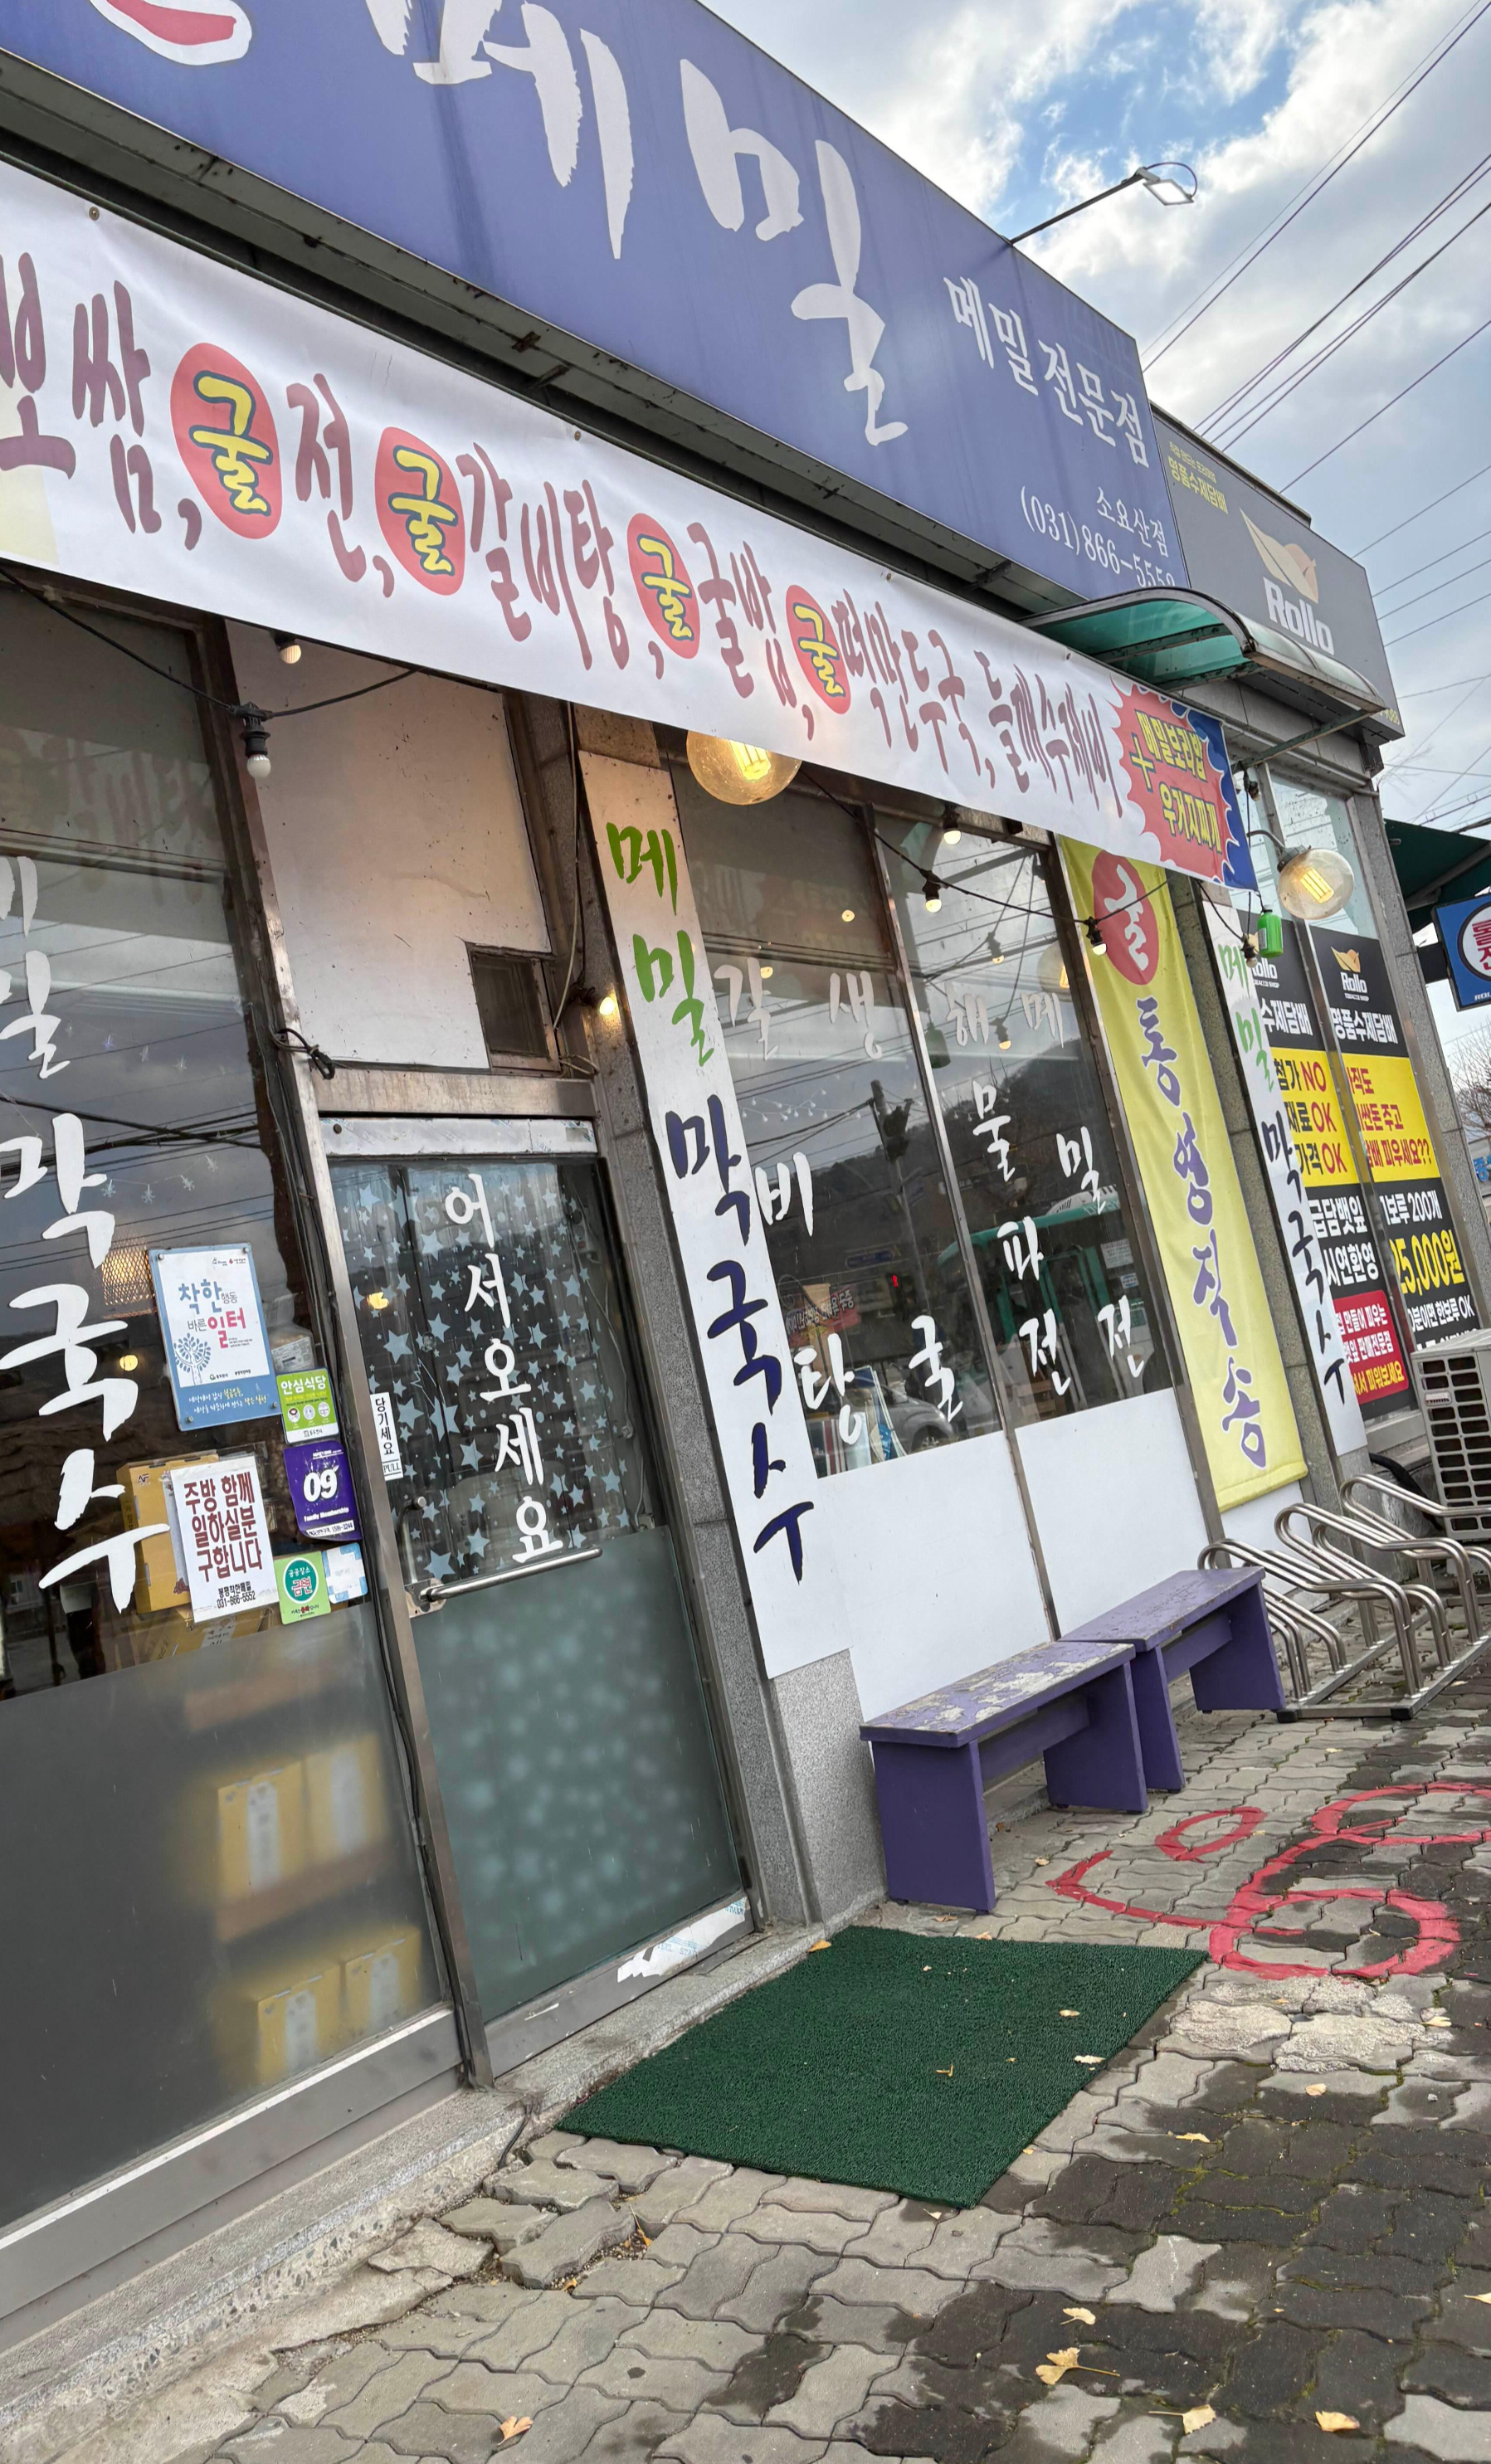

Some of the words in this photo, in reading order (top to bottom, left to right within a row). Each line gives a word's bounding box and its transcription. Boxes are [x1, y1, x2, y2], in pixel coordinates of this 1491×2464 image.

[943, 276, 1149, 468] 메밀전문점
[1096, 486, 1169, 558] 소요산점
[1263, 577, 1334, 655] Rollo
[1340, 971, 1368, 994] Rollo
[1329, 1007, 1399, 1045] 명품수제담배
[1300, 1061, 1327, 1093] NO
[1310, 1101, 1338, 1133] OK
[1380, 1103, 1405, 1132] 주고
[1321, 1142, 1348, 1175] OK
[1380, 1138, 1432, 1168] 피우세요??
[1408, 1190, 1443, 1224] 200개
[178, 1278, 222, 1315] 착한
[1458, 1294, 1475, 1319] OK
[187, 1318, 207, 1332] 바른
[207, 1307, 246, 1349] 일터
[1342, 1307, 1368, 1334] 만들어
[1364, 1303, 1388, 1328] 피우는
[280, 1375, 326, 1395] 안심식당
[375, 1397, 395, 1455] 당기세요
[303, 1465, 339, 1502] 09
[382, 1462, 402, 1473] PULL
[183, 1478, 217, 1515] 주방
[221, 1471, 256, 1508] 함께
[191, 1505, 258, 1549] 일하실분
[197, 1538, 263, 1583] 구합니다
[291, 1576, 314, 1597] 금연
